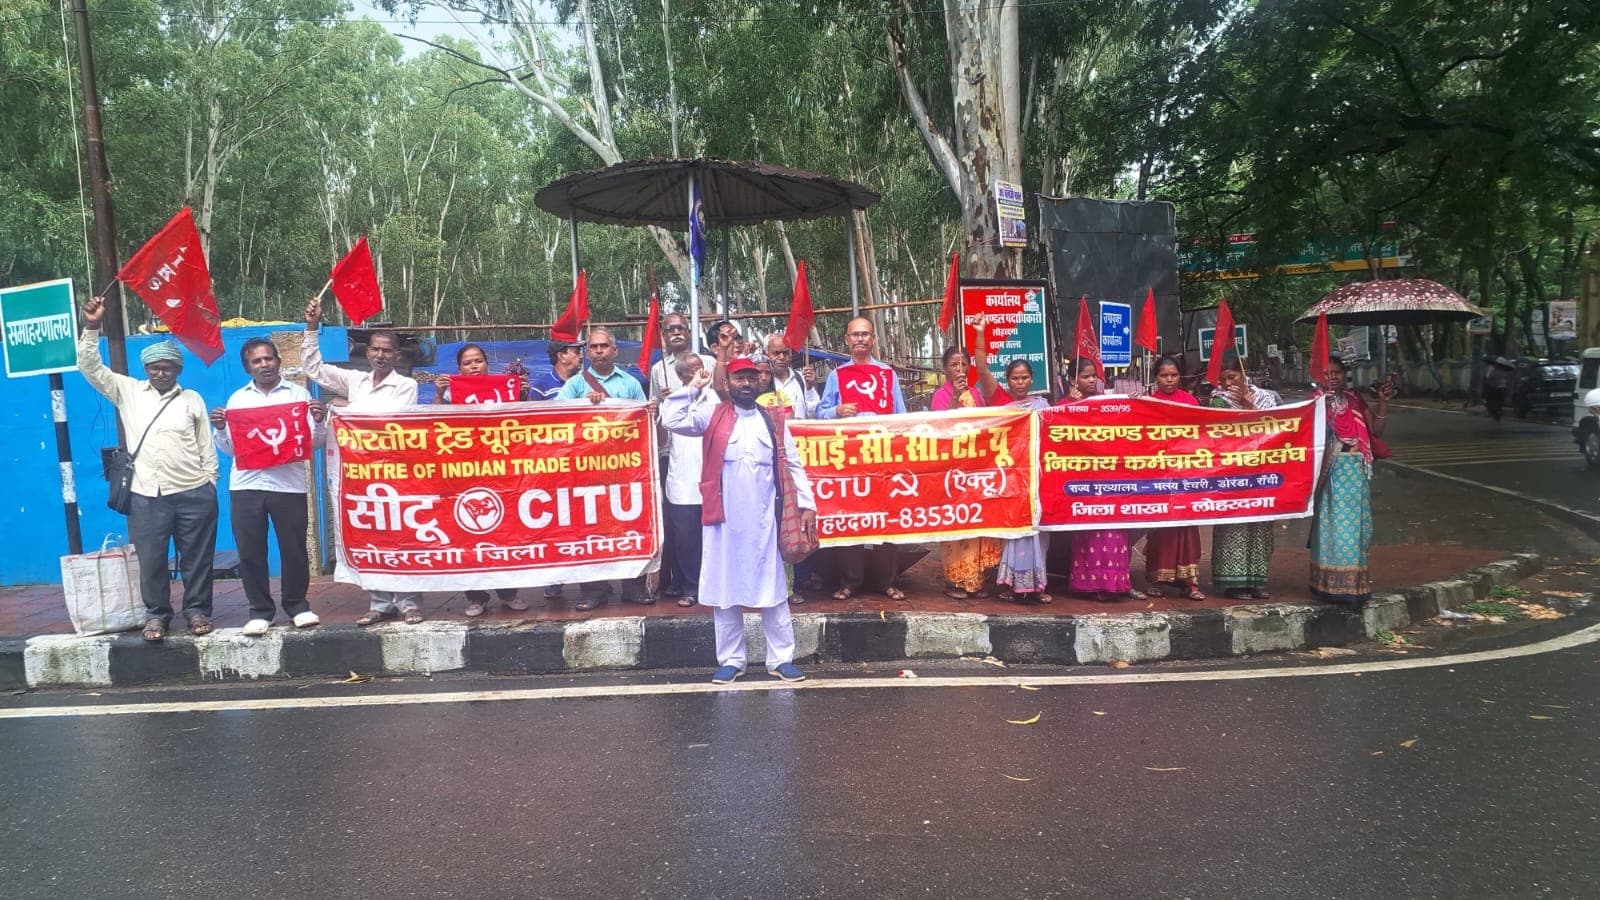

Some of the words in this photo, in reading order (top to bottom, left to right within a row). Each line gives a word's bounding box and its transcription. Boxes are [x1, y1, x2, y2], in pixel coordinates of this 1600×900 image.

[985, 292, 1021, 307] कार्यालय
[6, 313, 72, 346] समाहरणालय
[291, 407, 305, 457] CITU
[337, 422, 428, 451] भारतीय
[434, 422, 475, 455] ट्रेड
[478, 419, 576, 455] यूनियन
[582, 416, 641, 443] केन्द्र
[1048, 425, 1143, 442] झारखण्ड
[1146, 424, 1200, 440] राज्य
[1205, 416, 1301, 438] स्थानीय
[343, 462, 408, 479] CENTRE
[413, 463, 436, 479] OF
[442, 460, 506, 479] INDIAN
[511, 456, 571, 475] TRADE
[575, 451, 641, 471] UNIONS
[1044, 451, 1118, 472] निकाय
[1123, 448, 1214, 470] कर्मचारी
[1220, 442, 1307, 466] महासंघ
[810, 477, 871, 499] CTU
[1068, 483, 1090, 493] राज्य
[1093, 482, 1138, 495] मुख्यालय
[345, 482, 450, 545] सीटू
[518, 482, 643, 529] CITU
[816, 503, 984, 535] हरदगा-835302
[1071, 502, 1115, 516] जिला
[1121, 503, 1169, 515] शाखा
[1191, 496, 1276, 512] लोहरदगा
[350, 543, 466, 567] लोहरदगा
[473, 542, 548, 562] जिला
[555, 530, 645, 556] कमिटी
